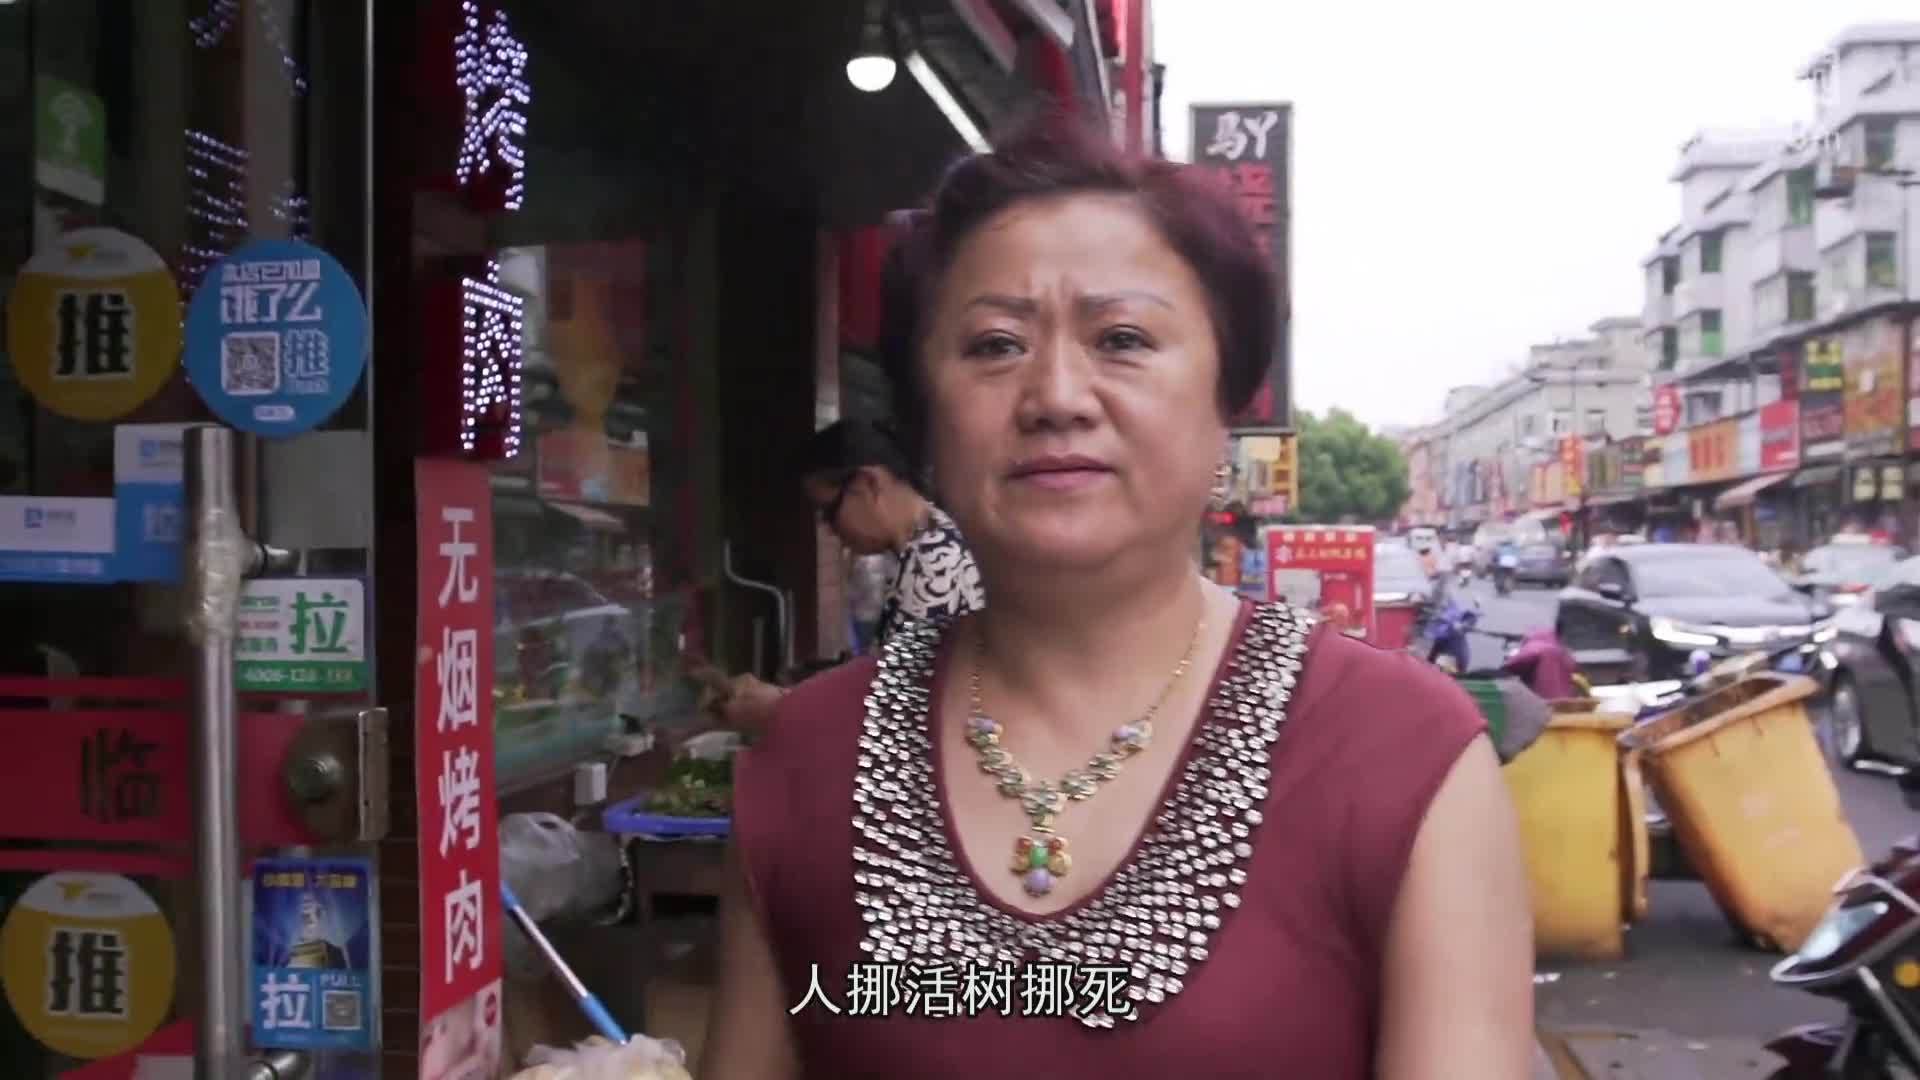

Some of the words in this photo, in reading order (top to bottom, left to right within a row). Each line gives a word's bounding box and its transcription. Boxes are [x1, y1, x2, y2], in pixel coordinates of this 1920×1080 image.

[55, 292, 131, 376] 推
[288, 591, 349, 655] 拉
[436, 506, 486, 984] 无烟烤肉
[50, 930, 125, 1015] 推
[259, 972, 312, 1029] 拉
